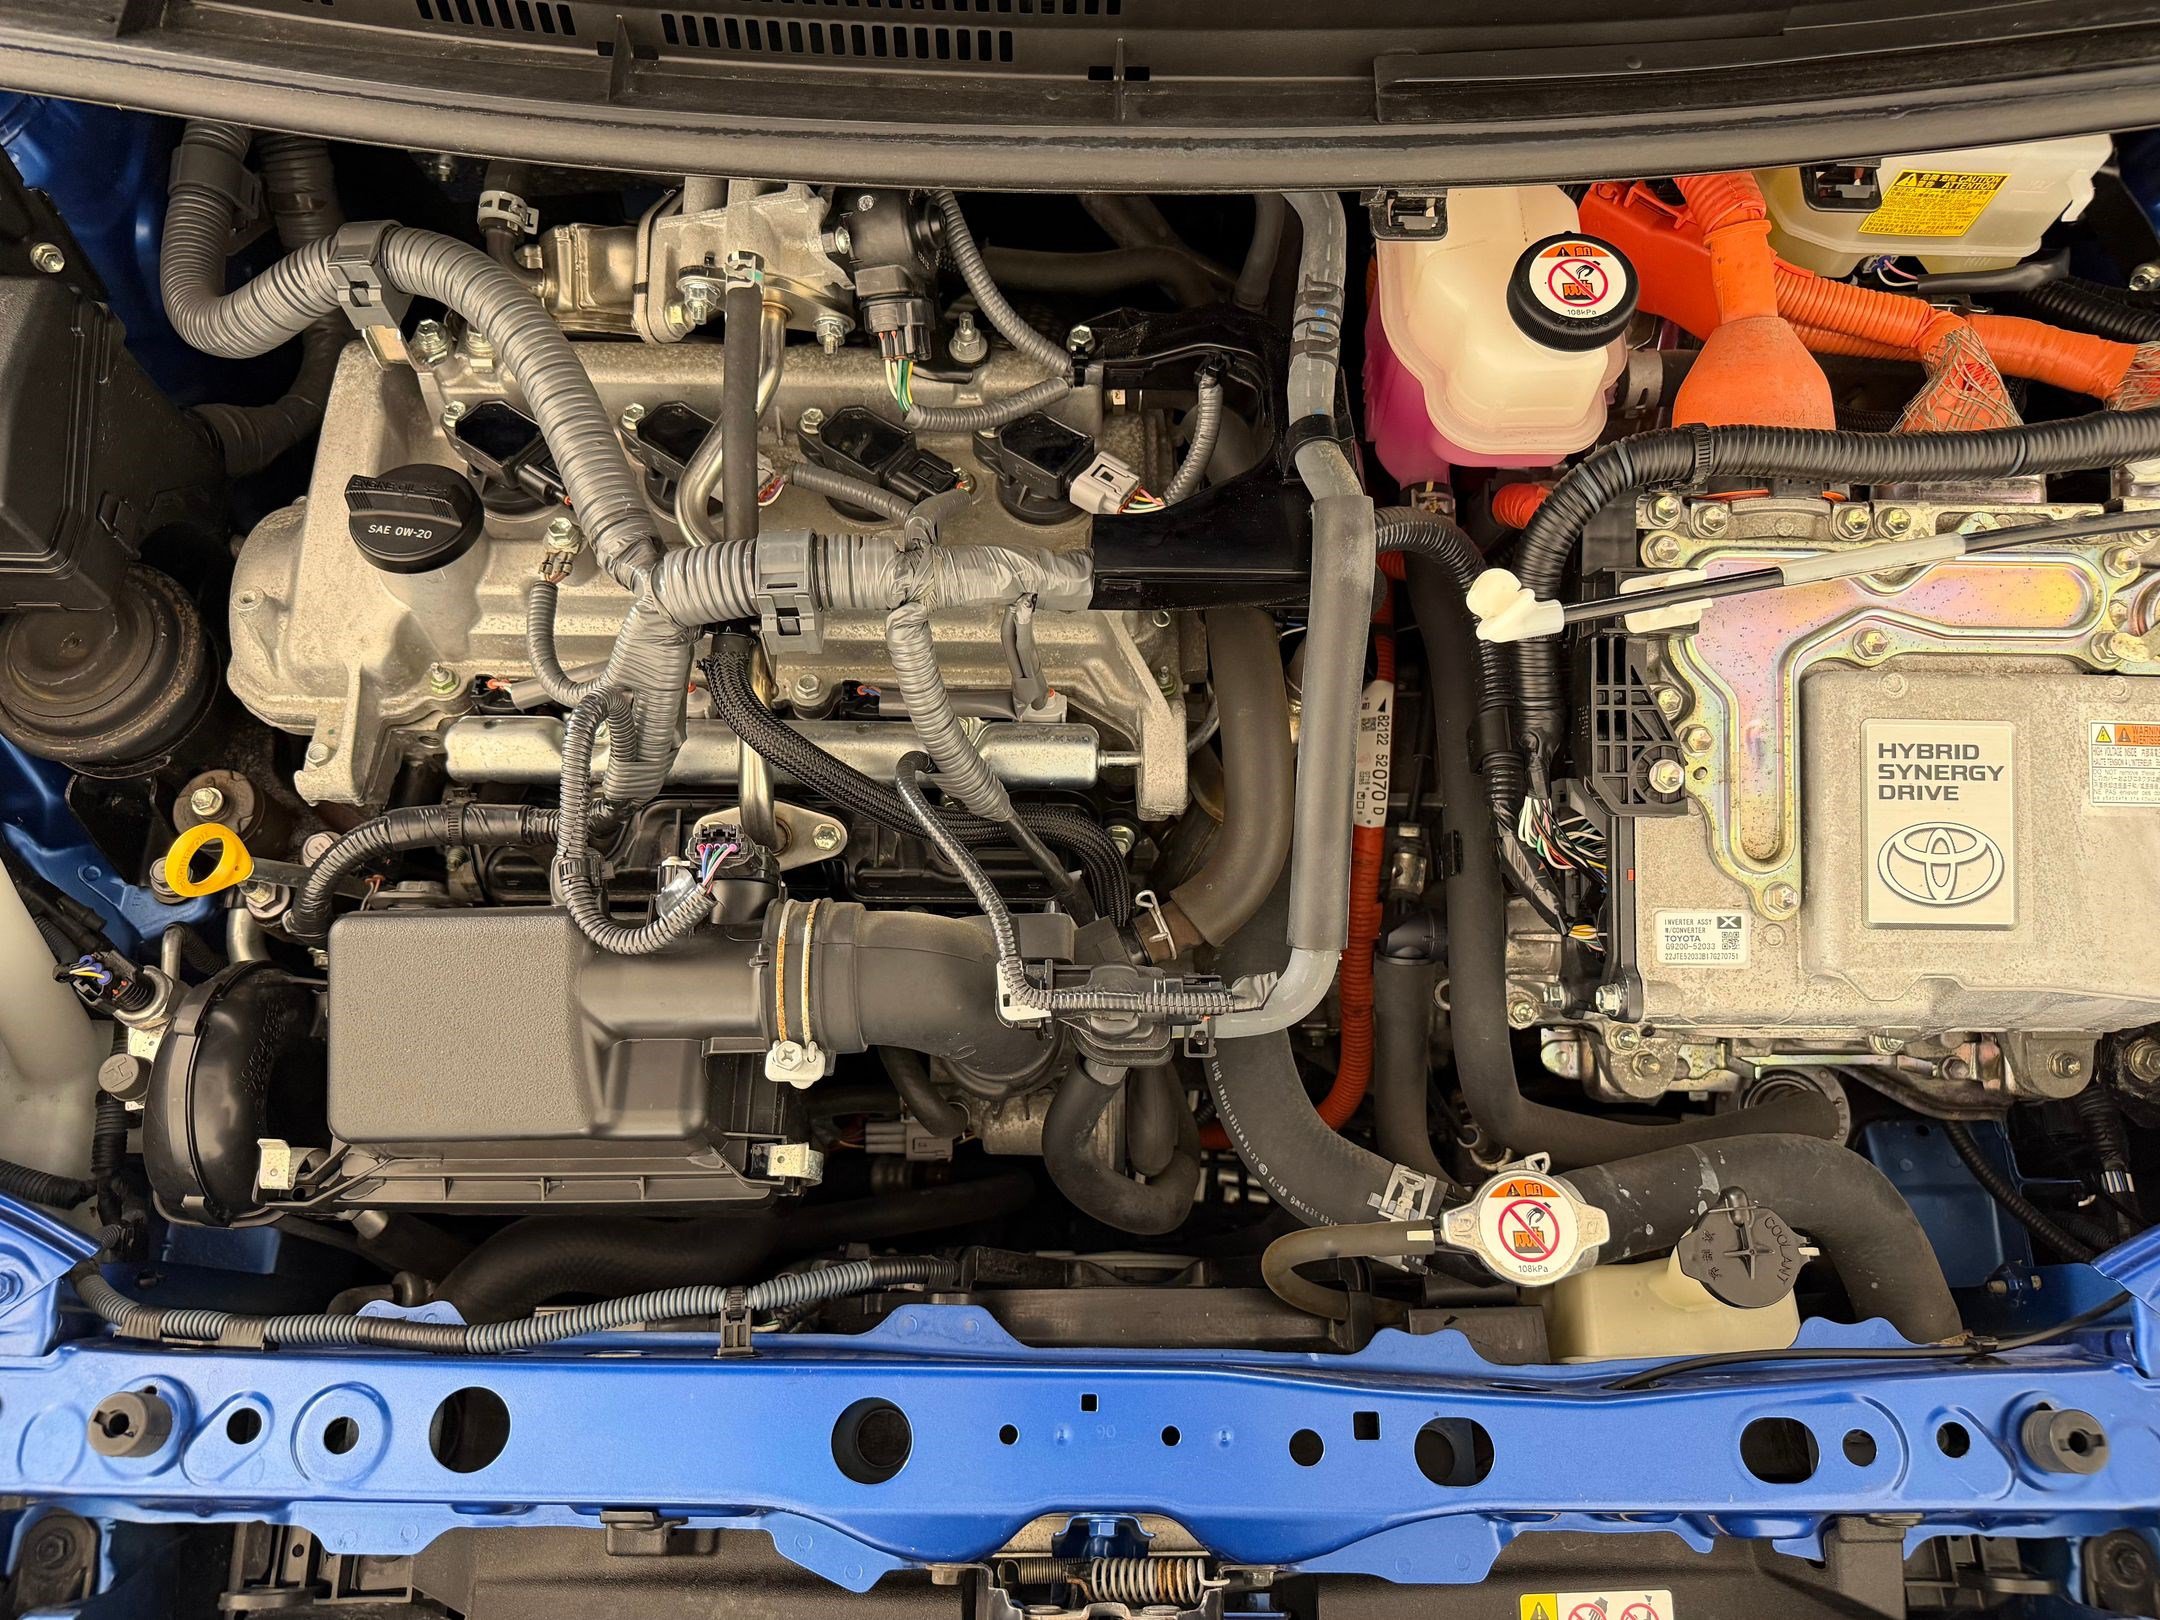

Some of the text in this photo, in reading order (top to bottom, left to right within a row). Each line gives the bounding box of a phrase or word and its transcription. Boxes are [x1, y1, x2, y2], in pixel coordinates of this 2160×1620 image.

[1942, 181, 1997, 190] ATTENTION
[1959, 175, 2003, 183] CAUTION
[368, 524, 432, 540] SAE 0W-20
[1878, 743, 1980, 760] HYBRID
[1371, 715, 1390, 816] 82122 52070 D
[1878, 764, 2005, 781] SYNERGY
[1878, 784, 1959, 801] DRIVE
[1764, 1216, 1792, 1285] COOLANT
[1518, 1265, 1549, 1273] 108kPa
